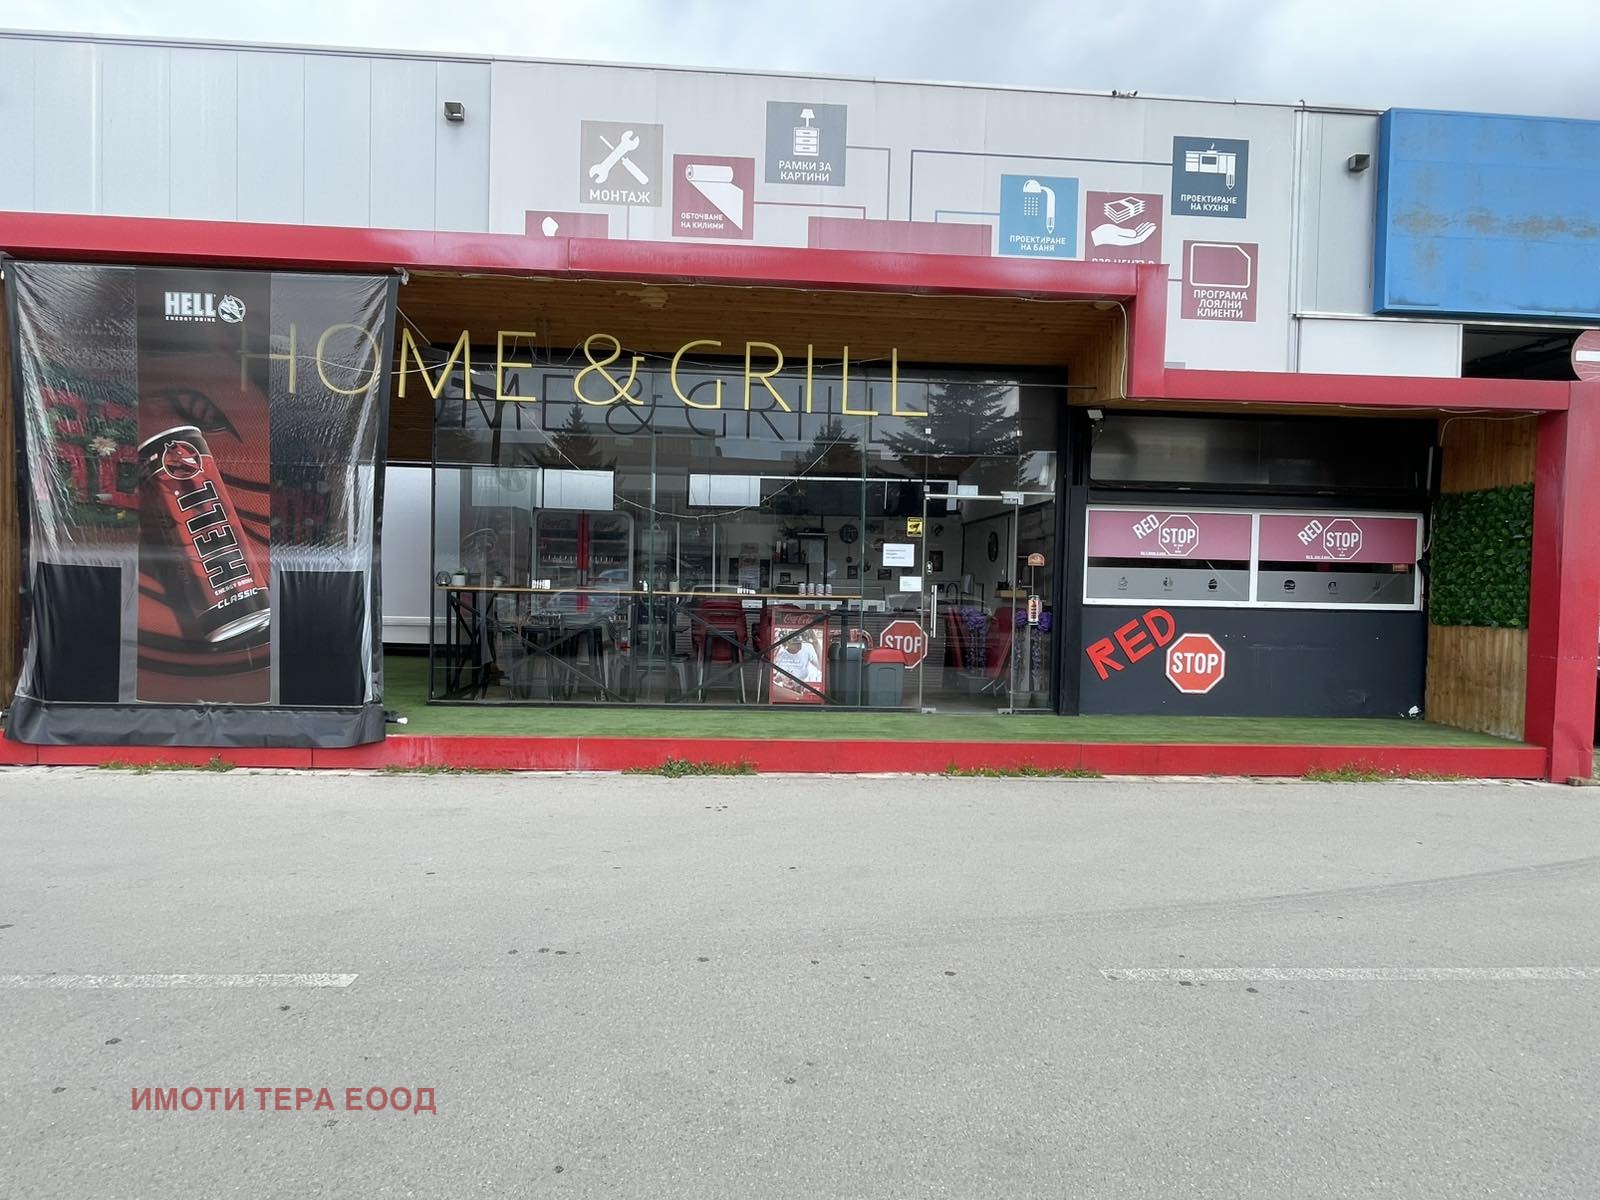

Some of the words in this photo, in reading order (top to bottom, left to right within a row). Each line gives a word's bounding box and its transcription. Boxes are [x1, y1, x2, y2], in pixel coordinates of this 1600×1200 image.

[779, 159, 817, 171] РАМКИ
[819, 161, 832, 172] ЗА
[780, 171, 830, 182] КАРТИНИ
[589, 189, 651, 203] МОНТАЖ
[1181, 194, 1238, 204] ПРОЕКТИРАНЕ
[1190, 202, 1201, 210] НА
[1202, 203, 1229, 212] КУХНЯ
[680, 212, 724, 221] ОБТОЧВАНЕ
[680, 221, 691, 229] НА
[692, 222, 724, 231] КИЛИМИ
[1009, 235, 1067, 245] ПРОЕКТИРАНЕ
[1020, 243, 1032, 251] НА
[1033, 243, 1055, 252] БАНЯ
[1193, 289, 1248, 300] ПРОГРАМА
[165, 292, 216, 317] HELL
[1198, 299, 1242, 309] ЛОЯЛНИ
[1197, 308, 1244, 318] КЛИЕНТИ
[240, 322, 537, 402] HOME
[574, 333, 645, 406] &
[670, 339, 928, 417] GRILL
[177, 481, 250, 589] HELL
[1132, 514, 1160, 539] RED
[1161, 528, 1196, 544] STOP
[1297, 520, 1324, 545] RED
[1326, 532, 1360, 547] STOP
[217, 587, 259, 609] CLASSIC
[885, 635, 922, 653] STOP
[1085, 607, 1176, 680] RED
[1172, 651, 1219, 674] STOP
